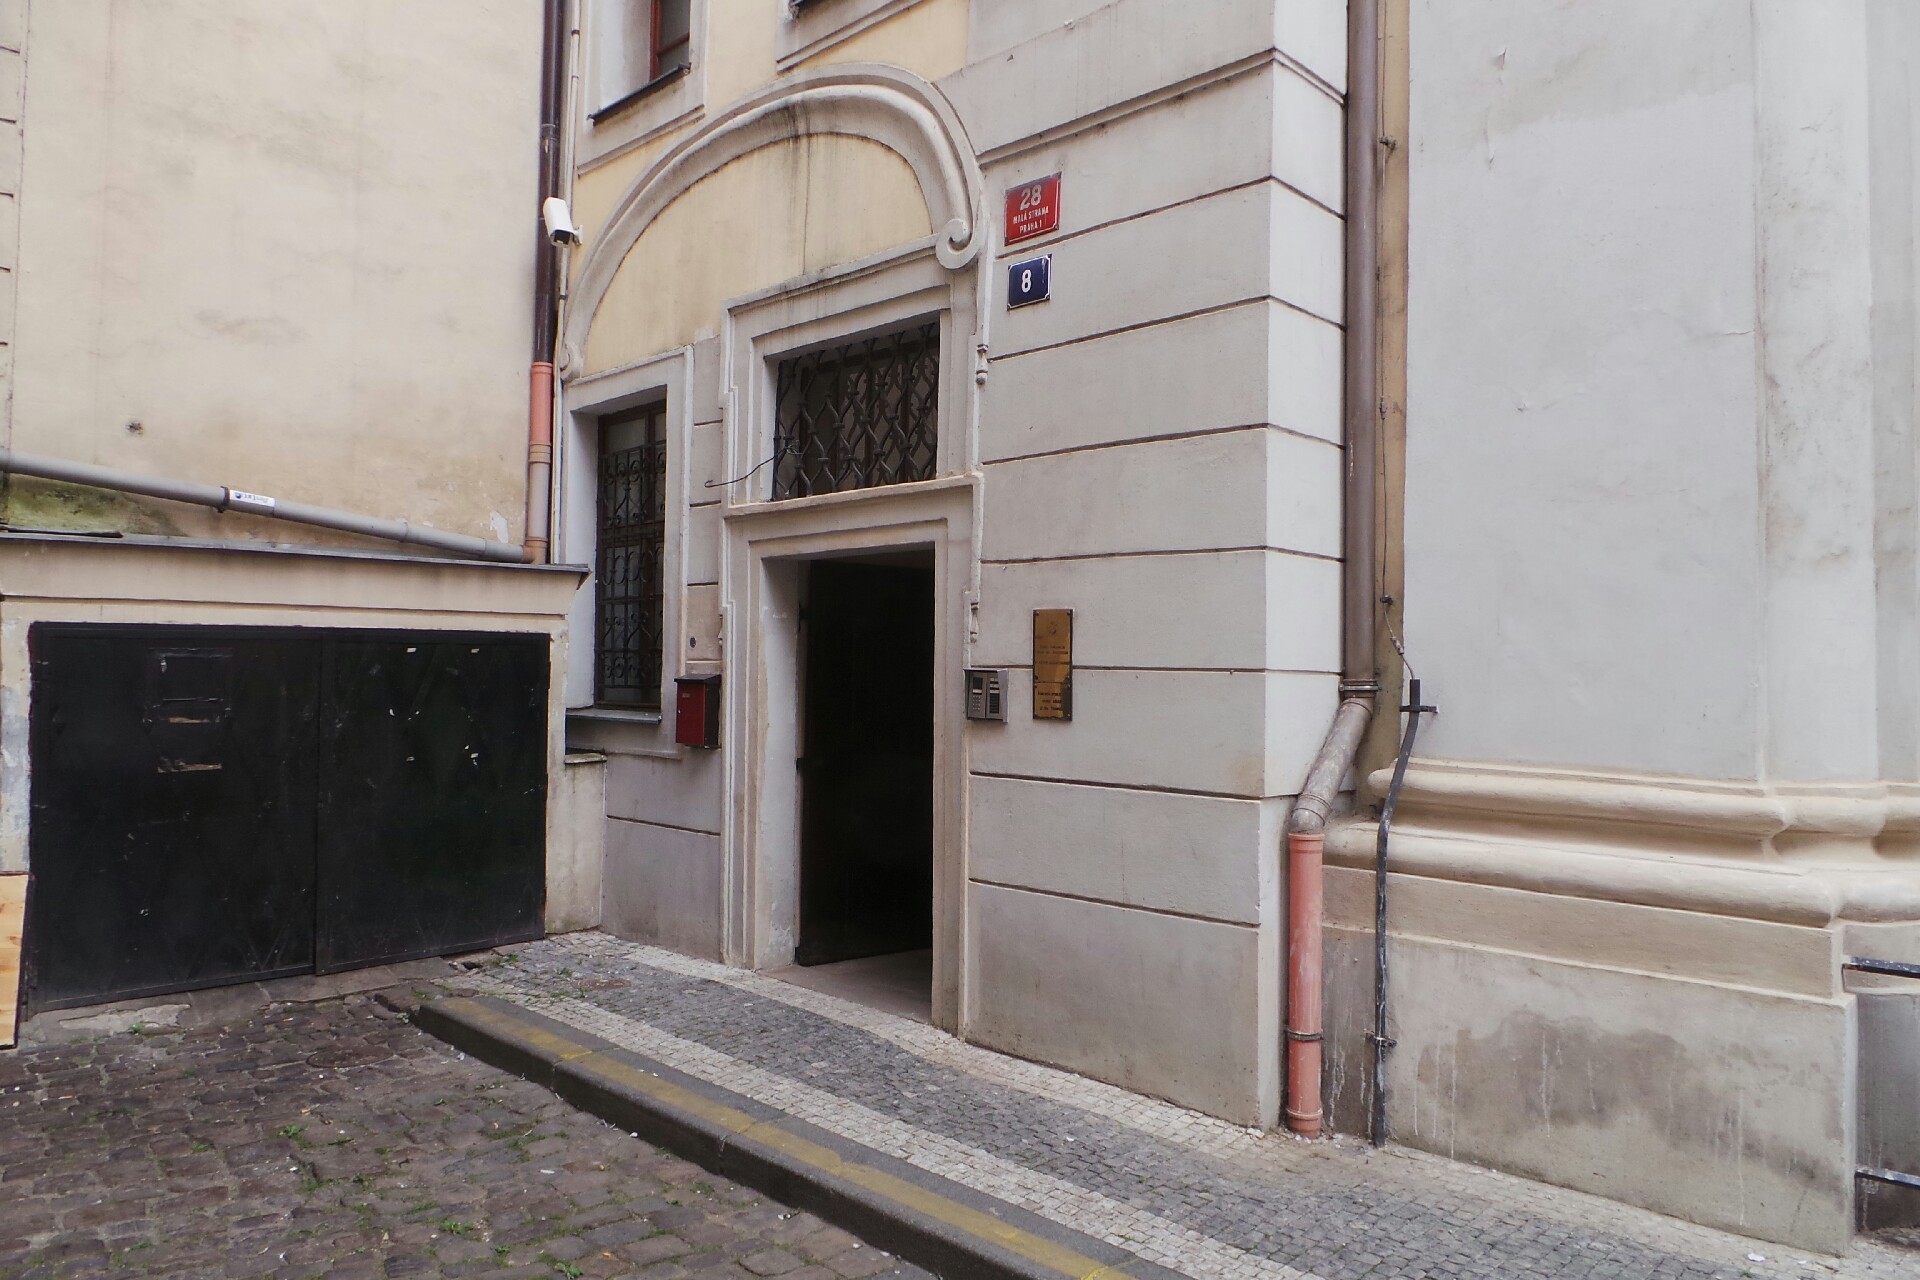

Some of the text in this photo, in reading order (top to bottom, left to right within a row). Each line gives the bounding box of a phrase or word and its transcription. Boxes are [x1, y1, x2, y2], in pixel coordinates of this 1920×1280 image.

[1019, 184, 1042, 211] 28
[1013, 205, 1049, 225] MALÁ STRANA
[1019, 221, 1039, 234] PRAHA
[1021, 269, 1032, 293] 8
